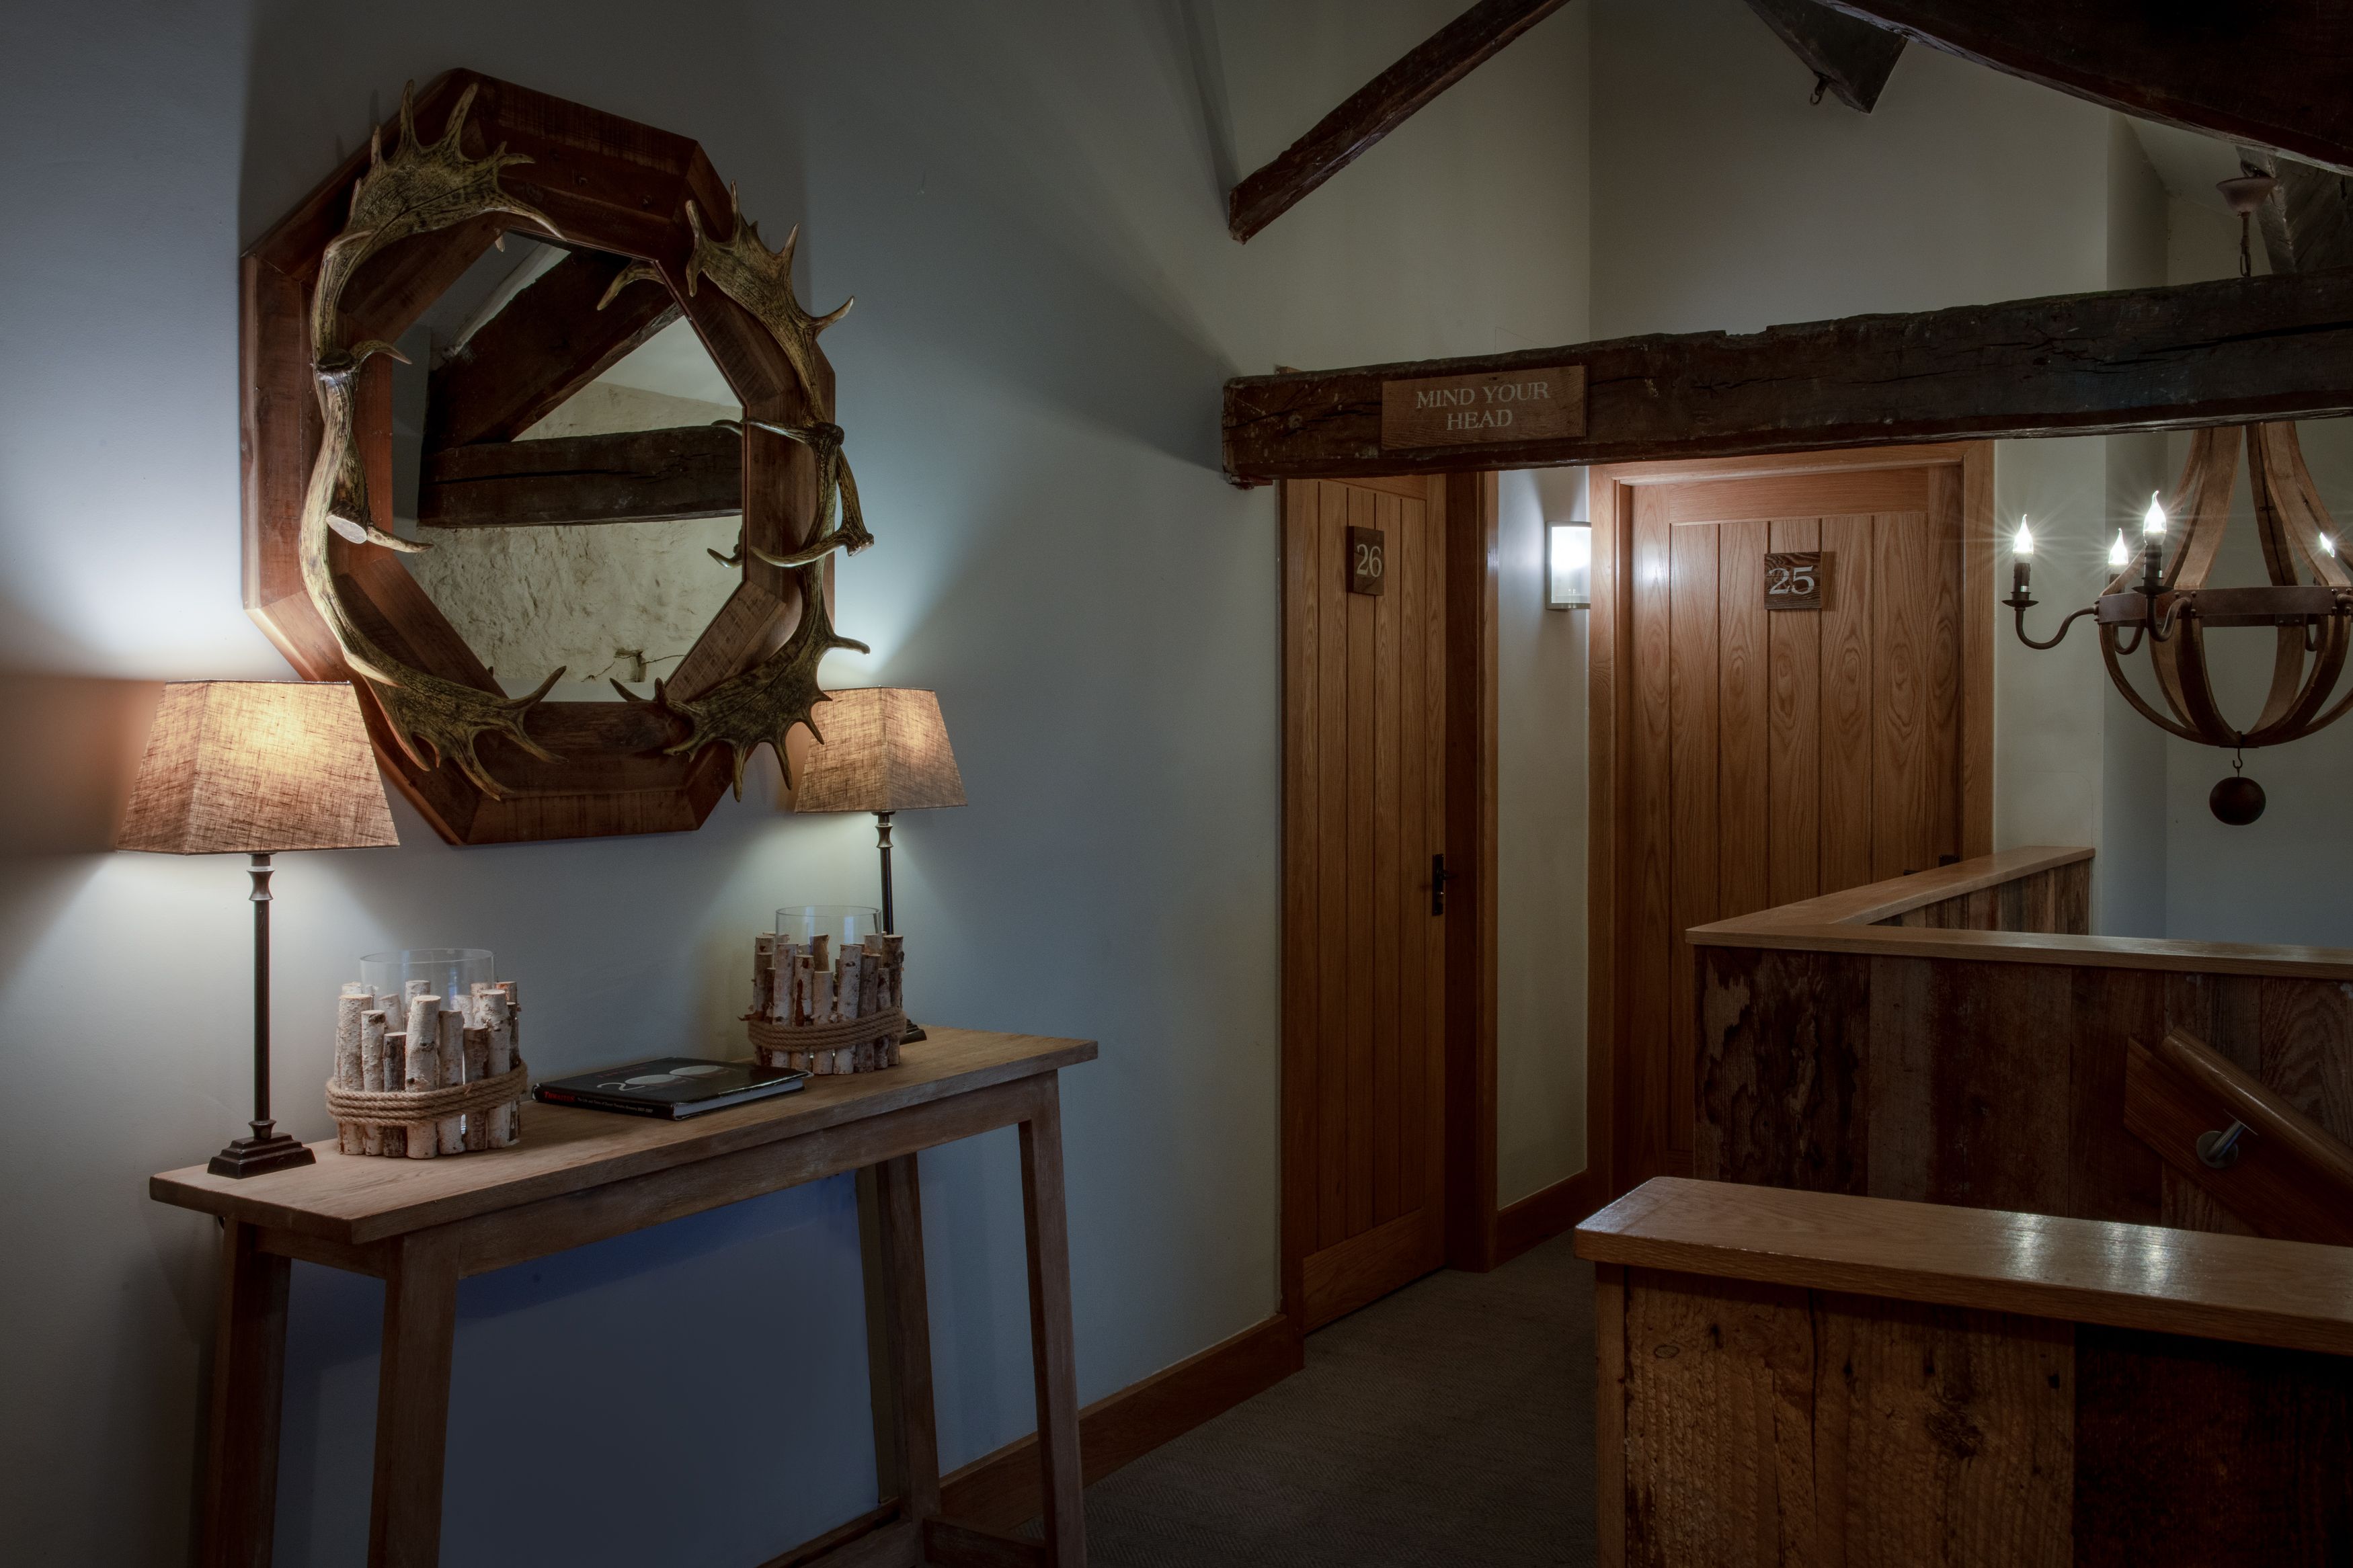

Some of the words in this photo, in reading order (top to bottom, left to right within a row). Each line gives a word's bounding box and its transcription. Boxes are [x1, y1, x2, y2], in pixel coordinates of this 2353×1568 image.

[1416, 388, 1475, 409] MIND
[1482, 382, 1550, 403] YOUR
[1446, 409, 1513, 430] HEAD
[1357, 543, 1382, 578] 26
[1769, 565, 1815, 595] 25
